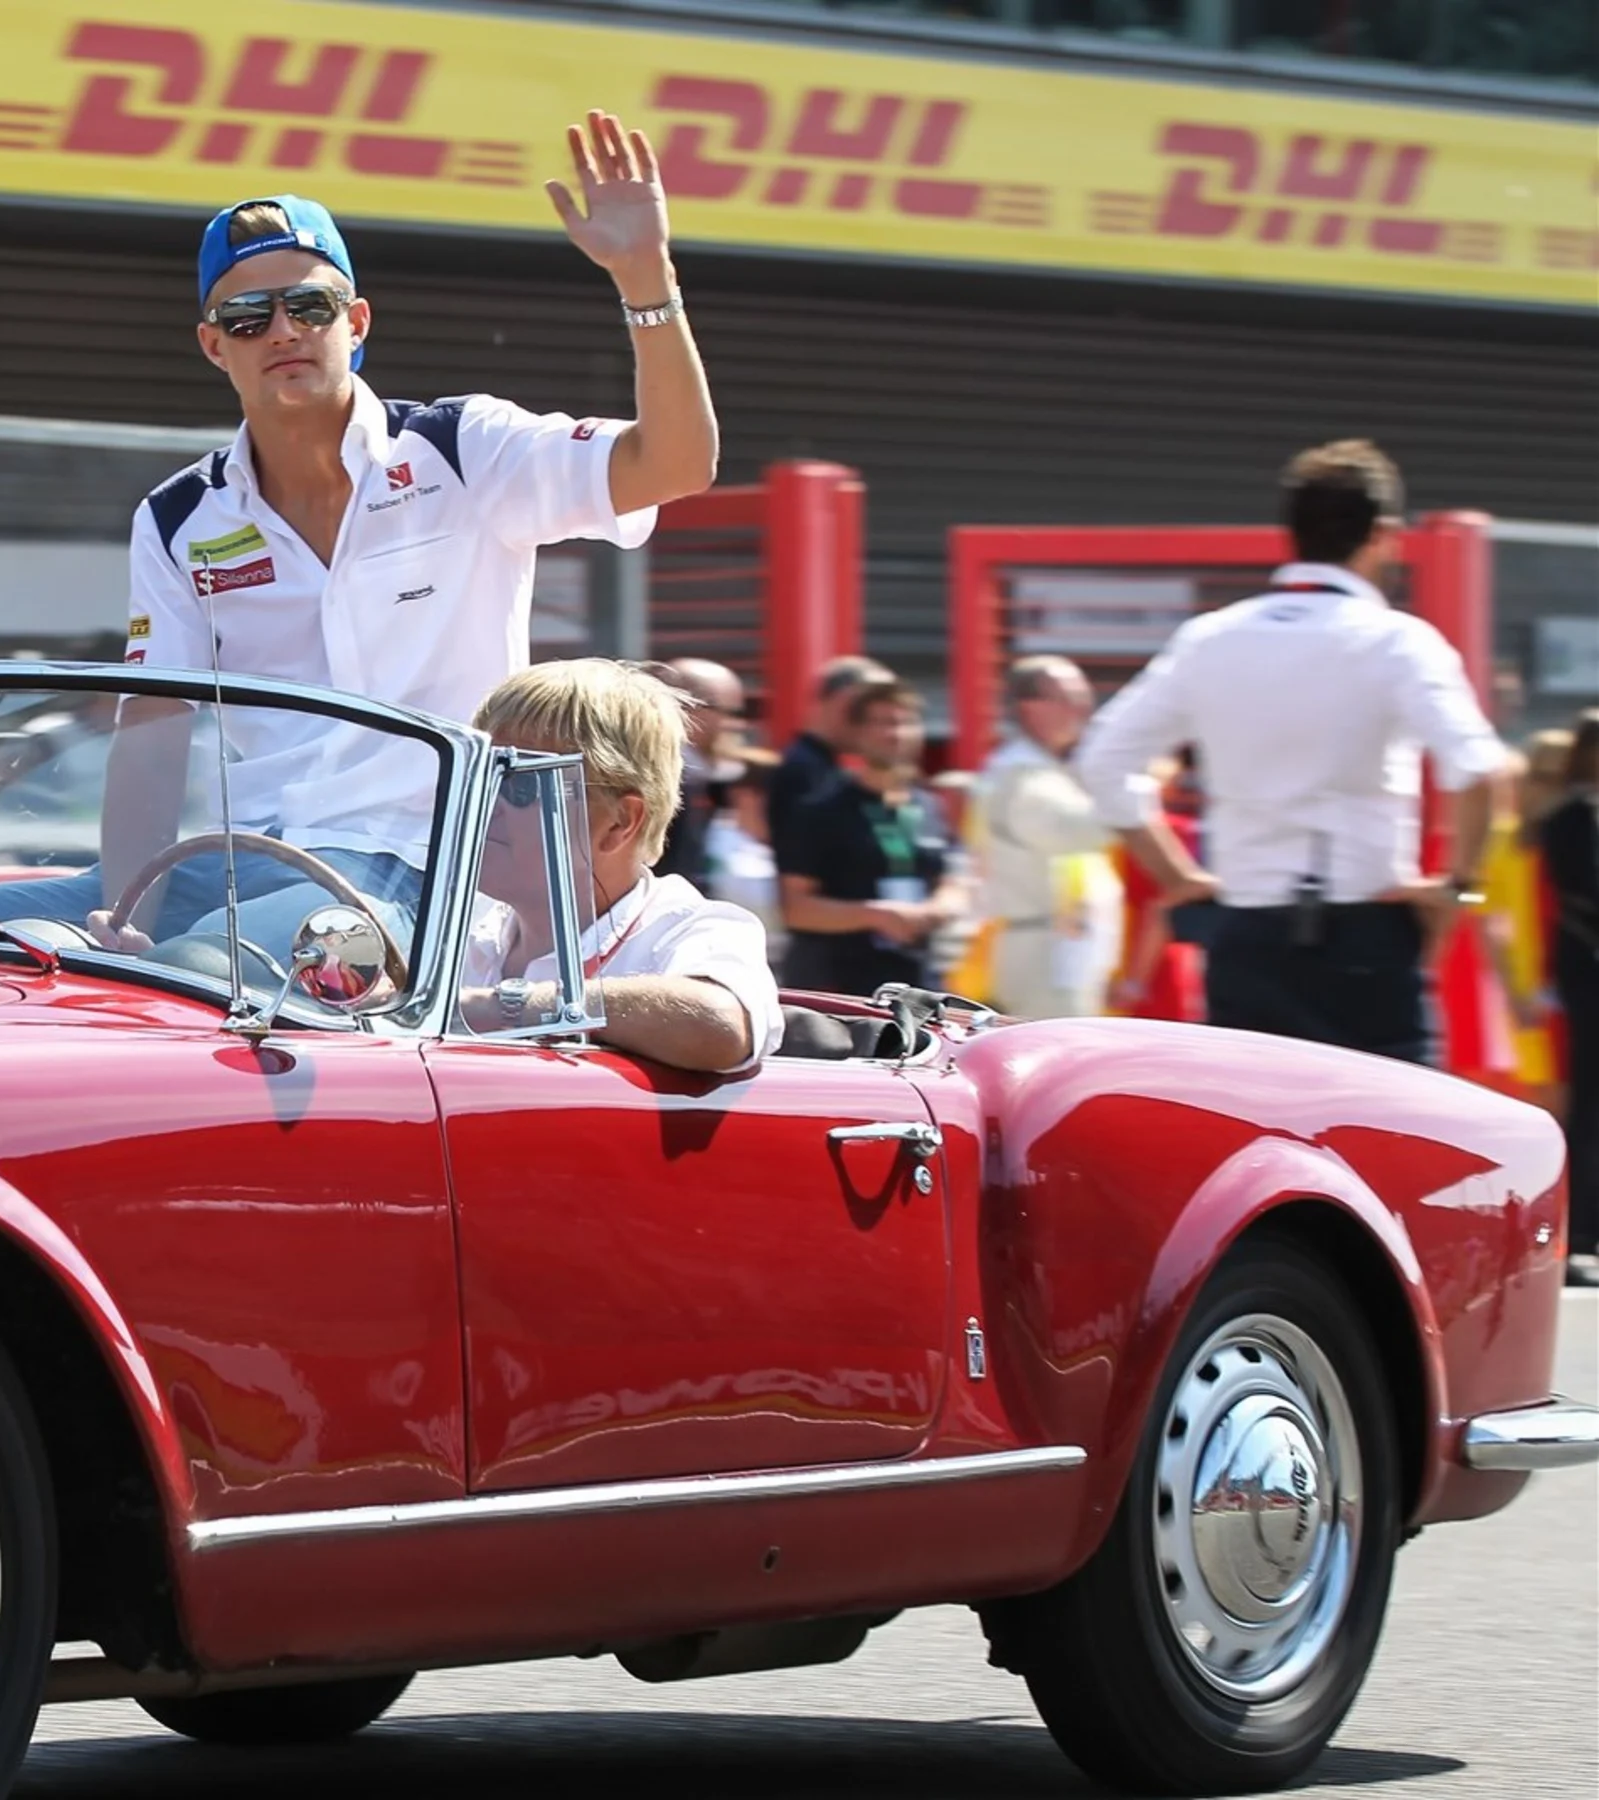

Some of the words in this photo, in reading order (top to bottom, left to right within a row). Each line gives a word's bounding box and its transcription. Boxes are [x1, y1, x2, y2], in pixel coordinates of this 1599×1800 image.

[56, 21, 450, 178] DHL
[652, 75, 983, 218] DHL
[1155, 123, 1442, 253] DHL
[417, 484, 442, 495] Team
